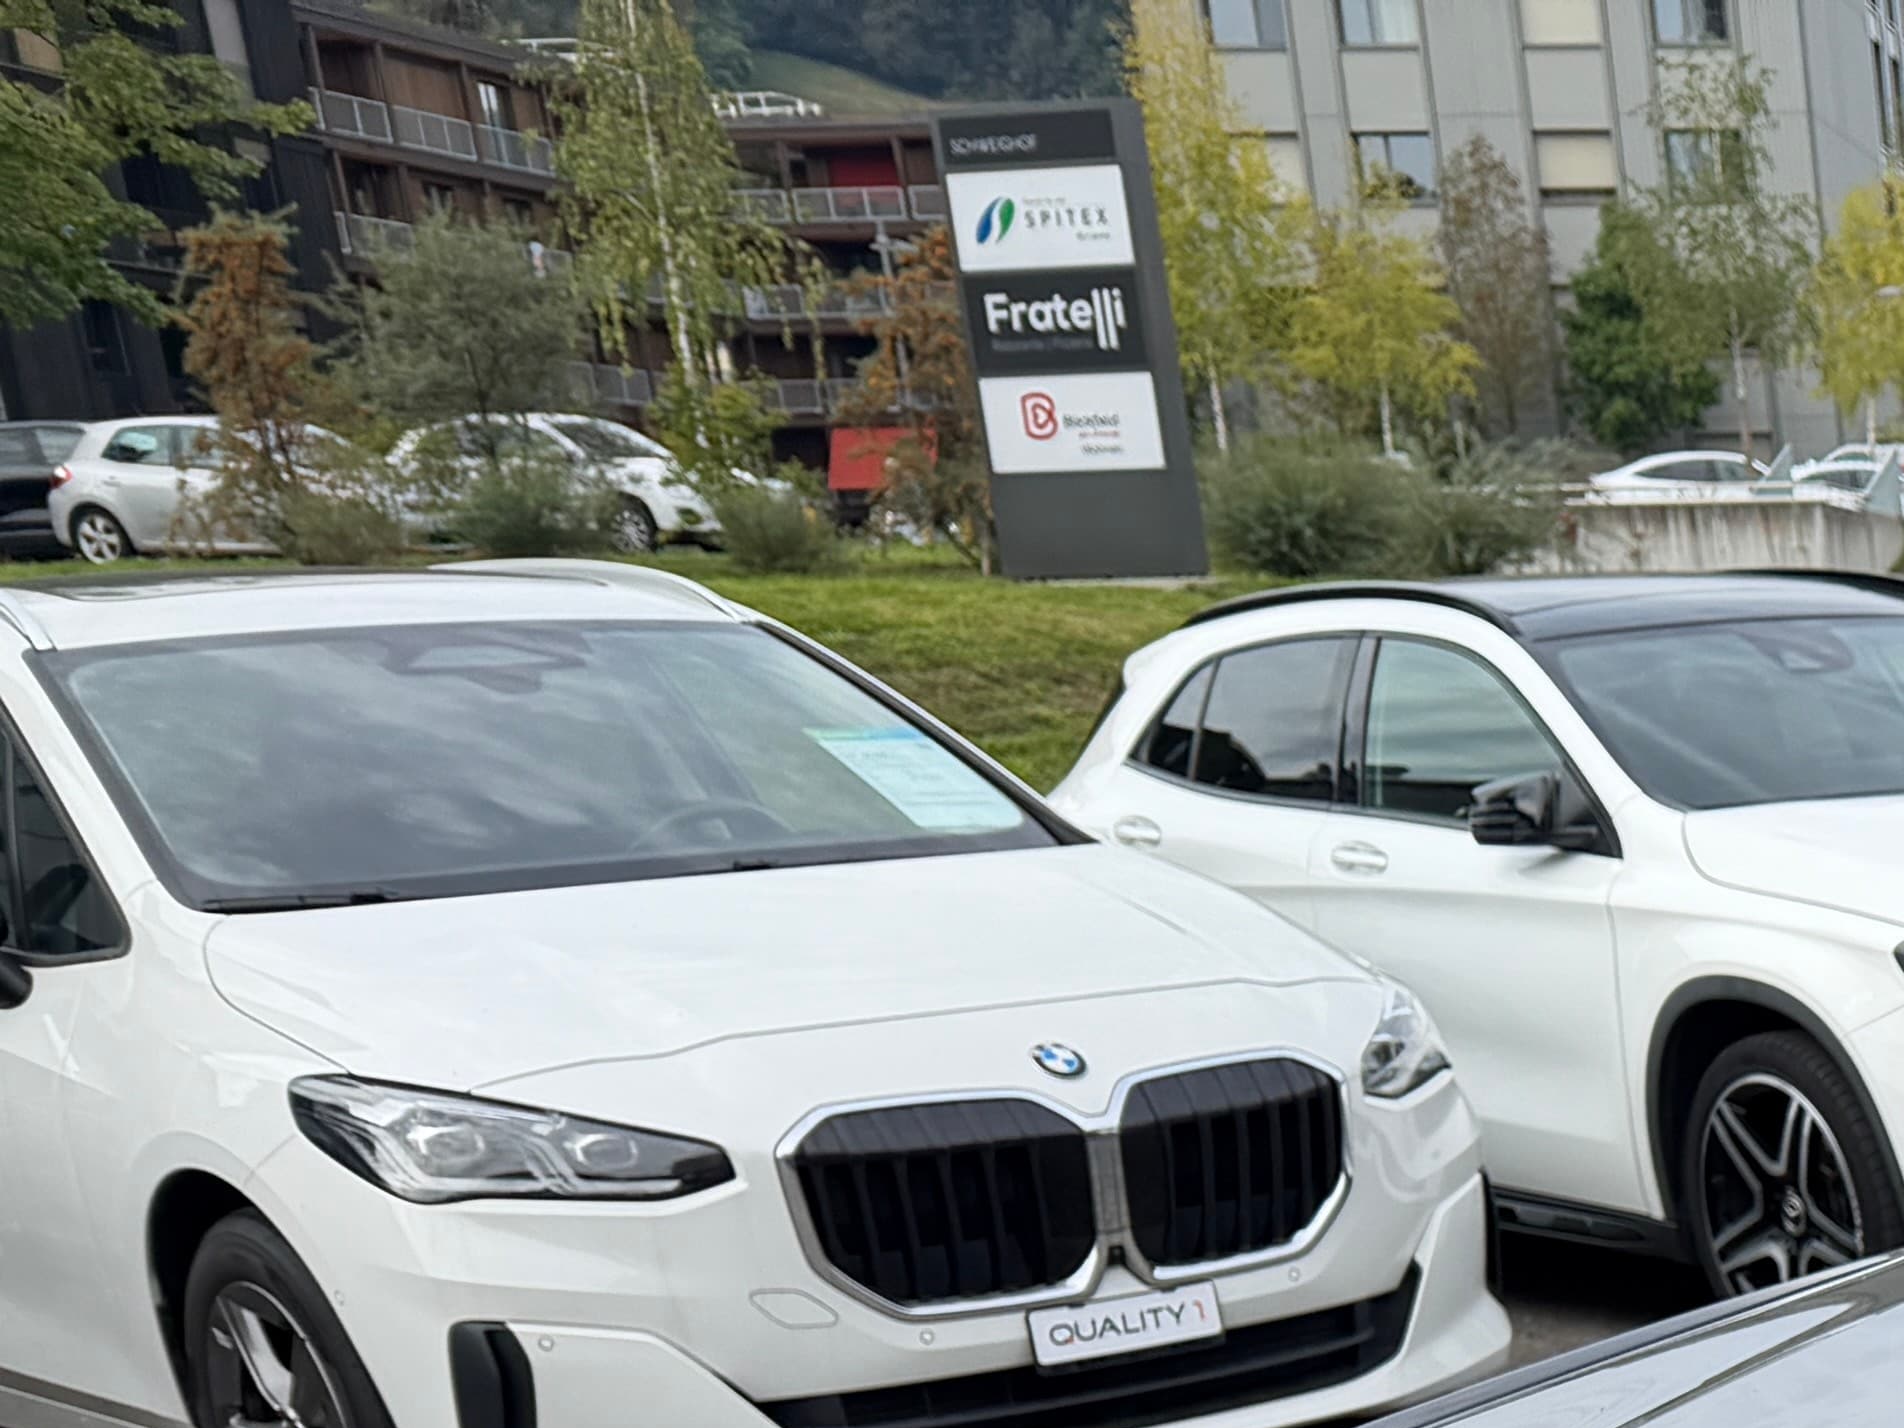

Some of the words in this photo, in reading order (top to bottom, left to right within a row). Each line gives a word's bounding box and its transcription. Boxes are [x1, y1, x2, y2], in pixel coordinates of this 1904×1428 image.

[1024, 207, 1109, 229] SPITEX
[983, 286, 1128, 351] Fratelli
[1049, 1301, 1186, 1346] QUALITY
[1193, 1299, 1206, 1321] 1
